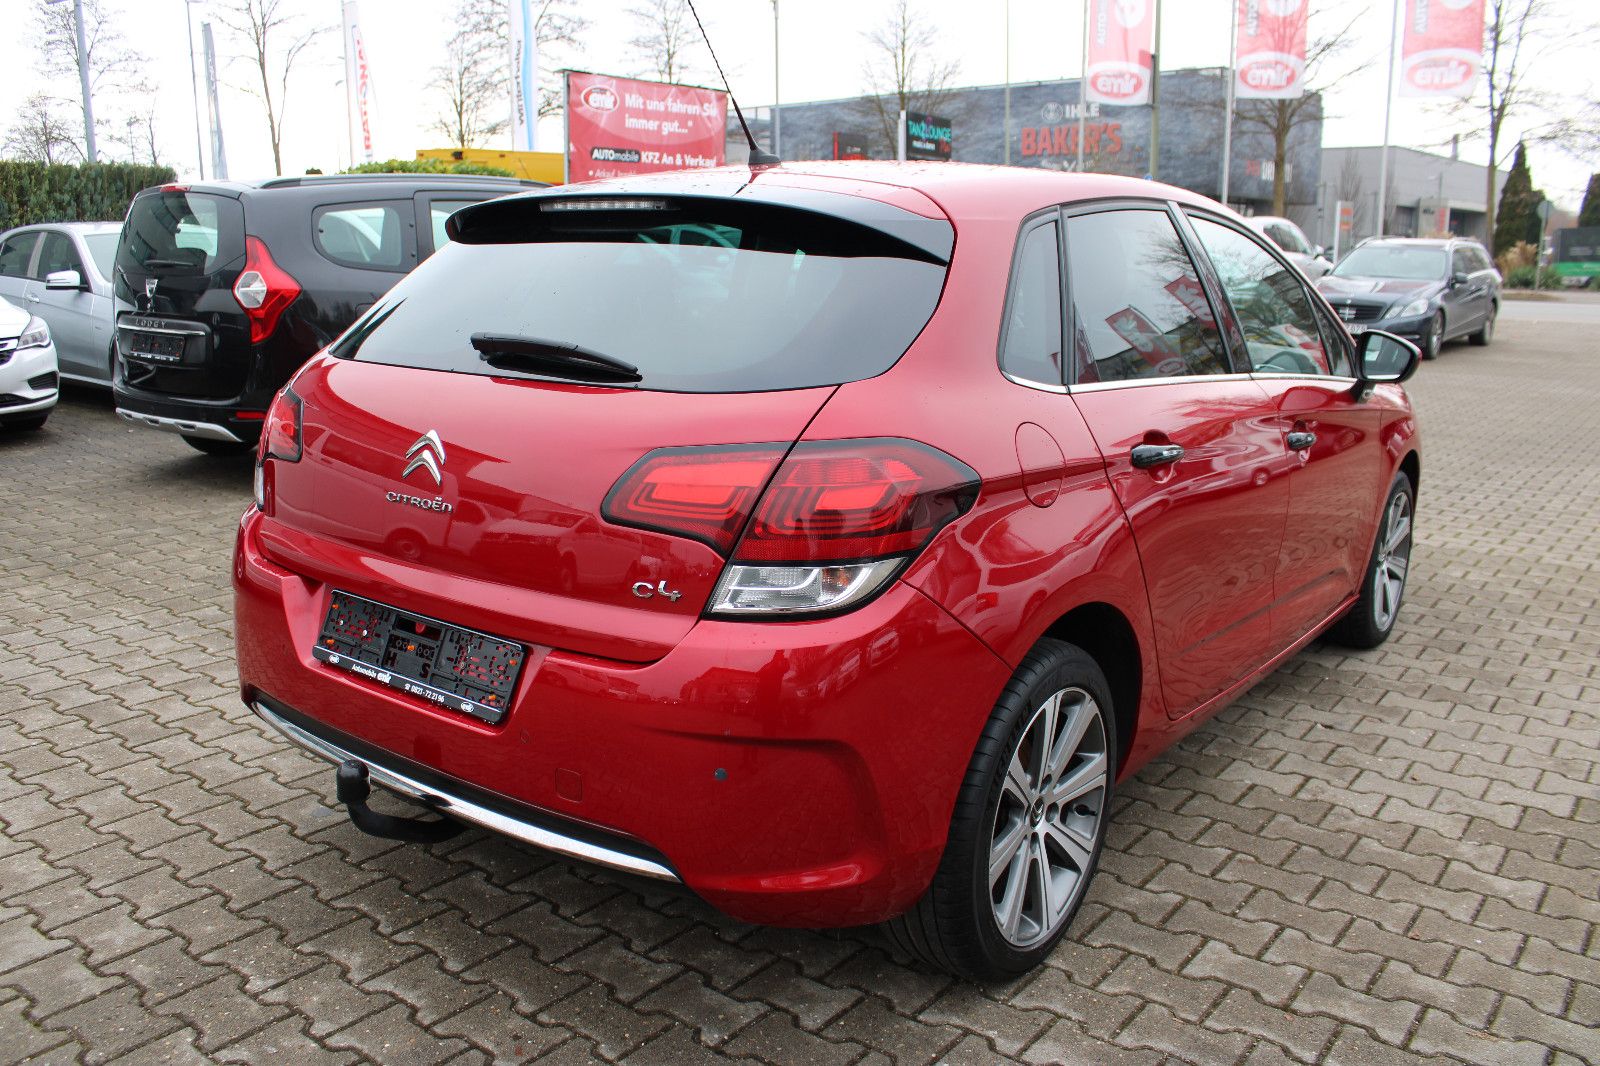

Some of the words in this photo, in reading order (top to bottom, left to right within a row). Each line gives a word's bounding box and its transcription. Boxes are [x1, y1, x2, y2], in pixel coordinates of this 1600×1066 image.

[1247, 63, 1292, 87] emir
[1414, 60, 1468, 84] emir
[1096, 73, 1137, 94] emir
[624, 92, 643, 110] Mit
[646, 99, 665, 113] uns
[667, 98, 699, 115] fahren
[624, 113, 659, 131] immer
[1021, 121, 1123, 157] BAKER'S
[592, 149, 639, 162] AUTOmobile
[641, 151, 660, 164] KFZ
[661, 153, 674, 165] An
[675, 153, 683, 166] &
[135, 318, 167, 329] LODGY
[632, 580, 682, 602] C4
